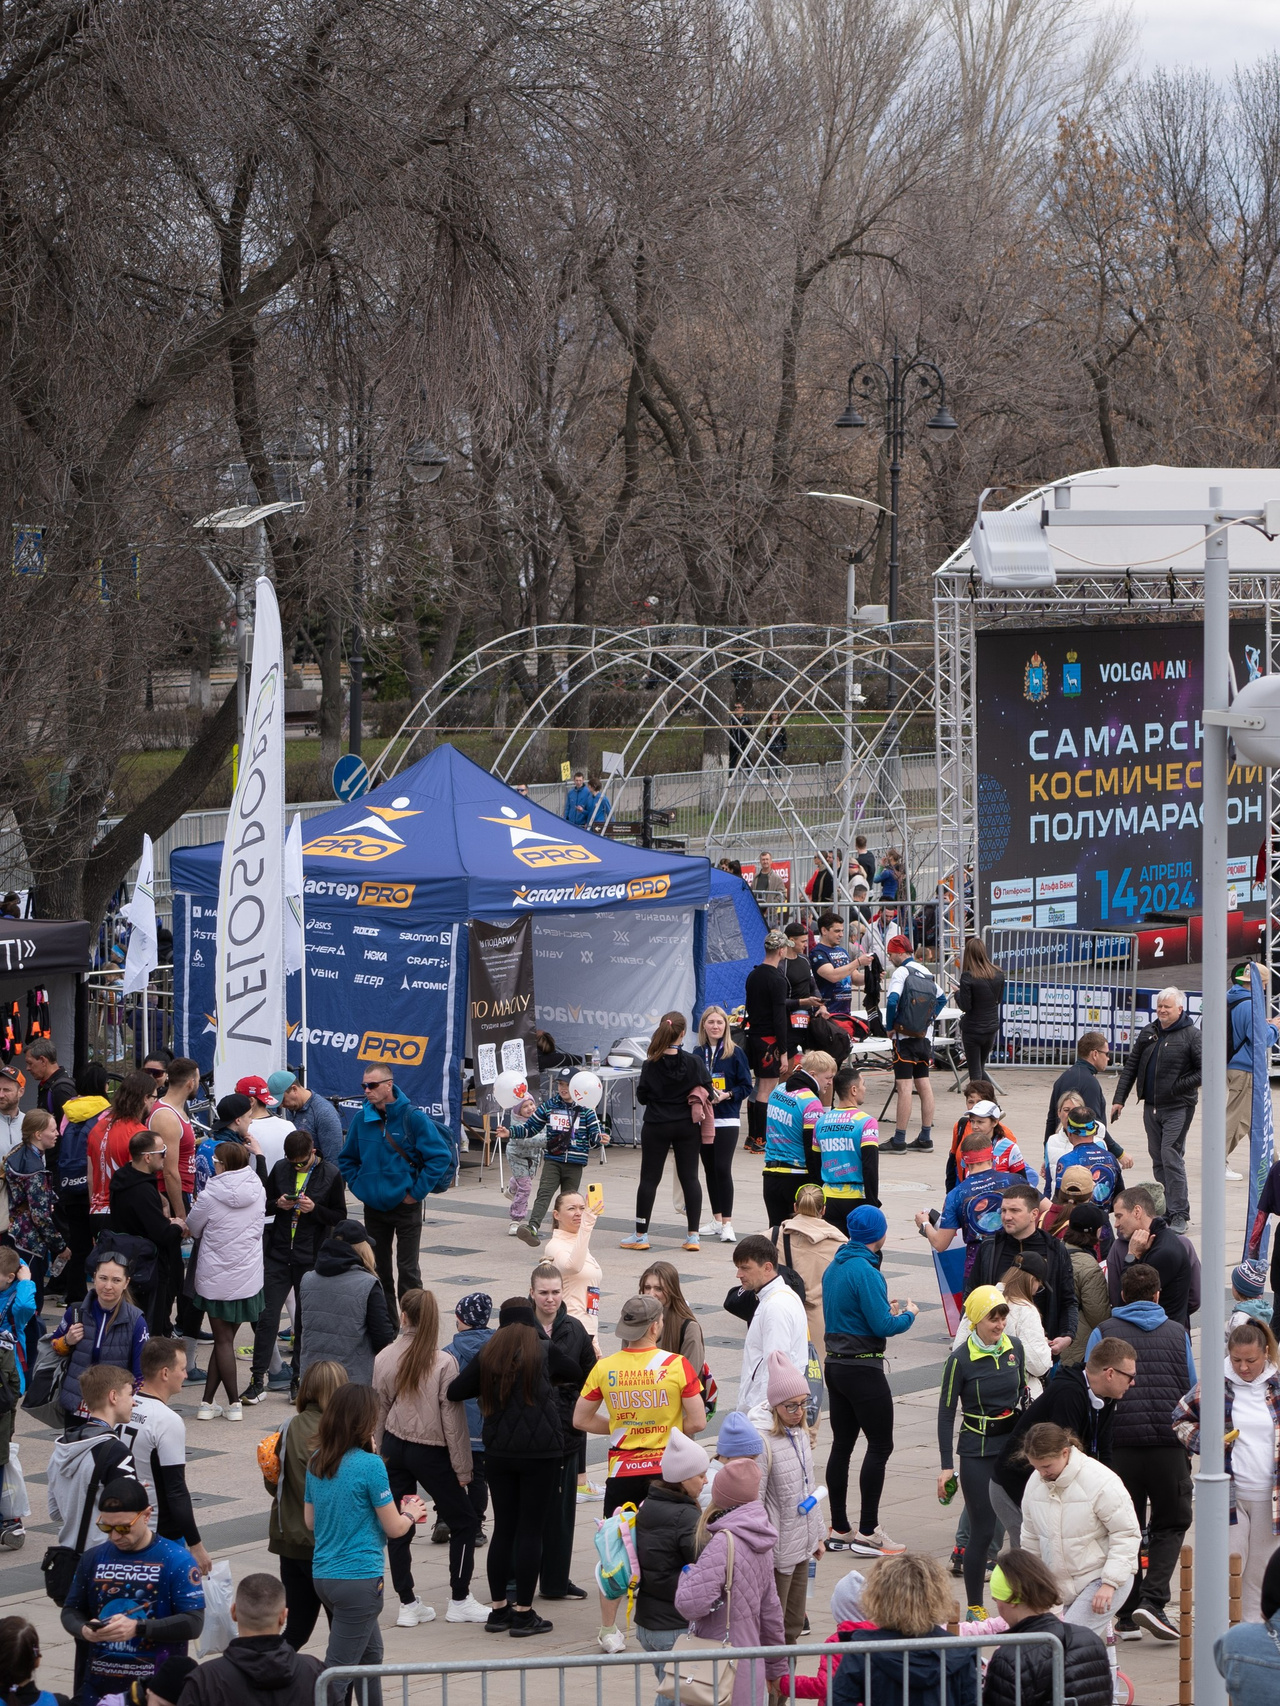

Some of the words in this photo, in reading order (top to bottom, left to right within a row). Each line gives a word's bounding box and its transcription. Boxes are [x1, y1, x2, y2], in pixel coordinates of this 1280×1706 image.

[1100, 660, 1186, 683] VOLGAMAN
[1029, 795, 1263, 844] ПОЛУМАРАОН
[303, 839, 388, 857] PRO
[521, 848, 590, 865] PRO
[1140, 861, 1192, 882] АПРЕЛЯ
[629, 879, 668, 897] PRO
[1060, 880, 1075, 889] Банк
[363, 886, 409, 904] PRO
[1096, 867, 1138, 919] 14
[1140, 881, 1196, 914] 2024
[303, 944, 337, 956] CHER
[1154, 937, 1164, 958] 2
[406, 956, 440, 967] CRAFT
[311, 968, 339, 980] Völkl
[411, 980, 448, 991] ATOMIC
[365, 1037, 421, 1059] PRO
[825, 1112, 851, 1120] SAMARA
[820, 1124, 855, 1133] FINISHER
[820, 1137, 855, 1152] RUSSIA
[68, 1175, 87, 1185] asics
[608, 1370, 616, 1387] 5
[618, 1368, 654, 1378] SAMARA
[618, 1379, 655, 1387] MARATHON
[608, 1389, 670, 1410] RUSSIA
[630, 1425, 668, 1436] ЛЮБЛЮ!
[625, 1459, 662, 1470] VOLGAM
[95, 1570, 160, 1582] КОСМОС
[90, 1666, 155, 1676] ПОЛУМАРАФОН
[92, 1660, 155, 1670] КОСМИЧЕСКИЙ
